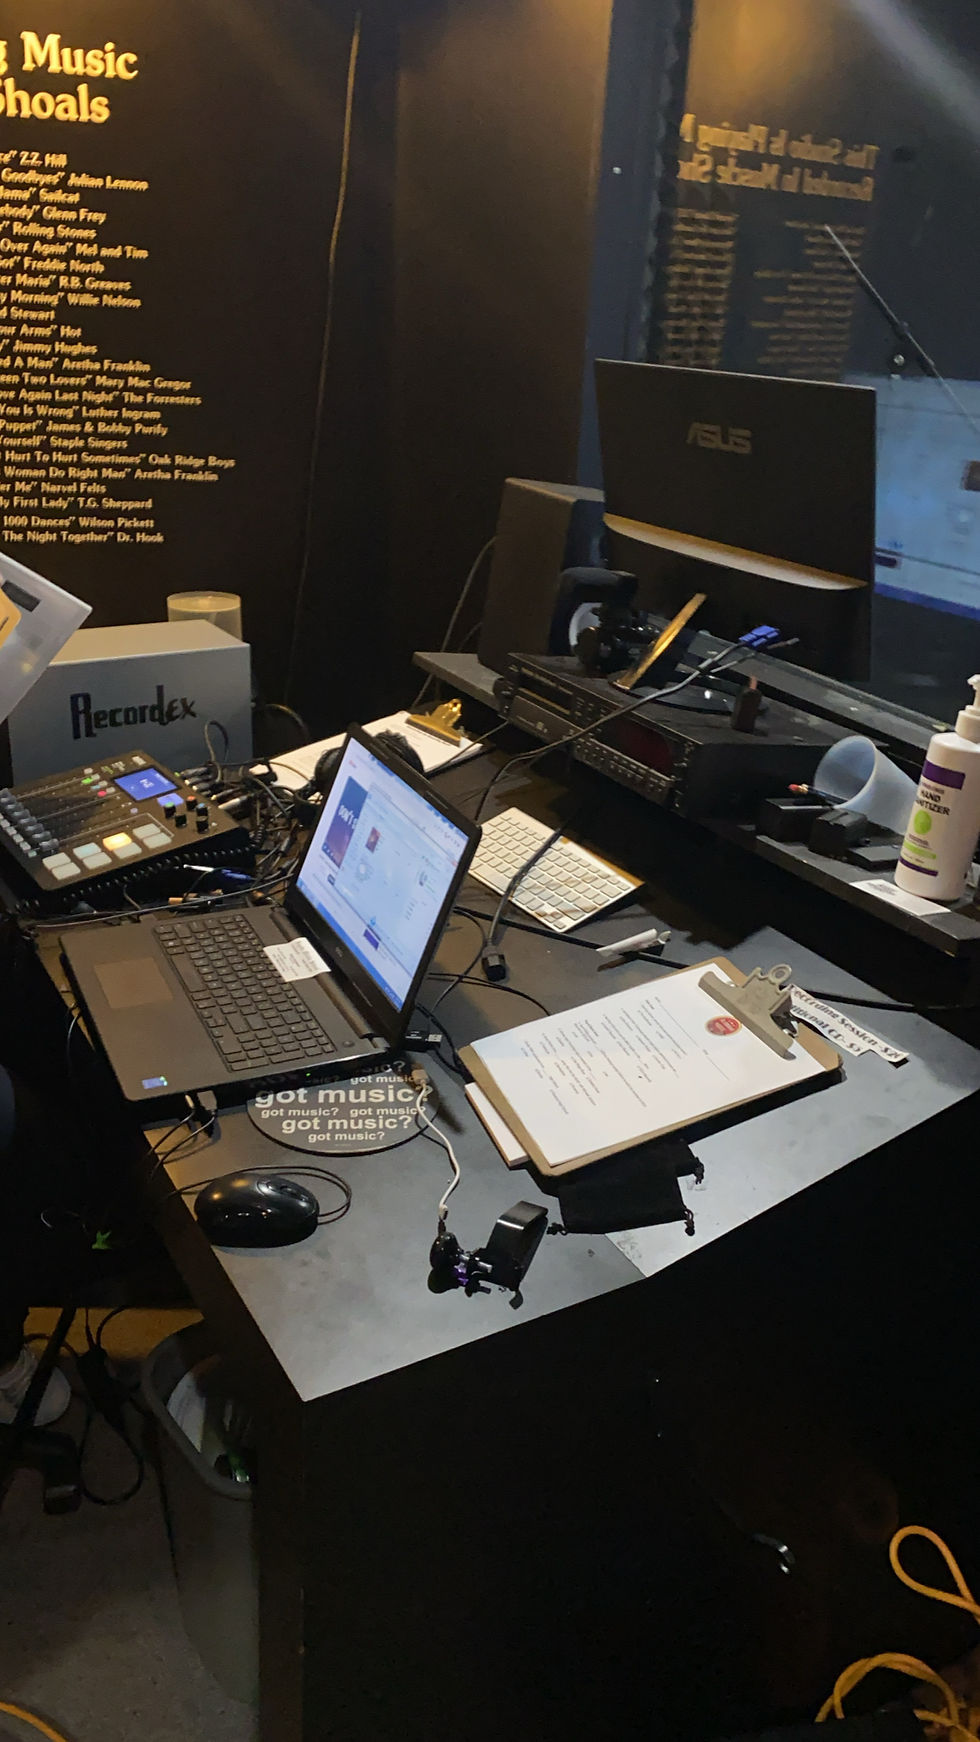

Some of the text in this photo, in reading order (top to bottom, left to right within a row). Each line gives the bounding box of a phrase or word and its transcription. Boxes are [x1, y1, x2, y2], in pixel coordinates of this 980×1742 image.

[20, 31, 139, 80] Music
[106, 175, 149, 191] Lennon
[42, 206, 78, 221] Glenn
[79, 208, 107, 225] Frey
[13, 221, 55, 239] Rolling
[56, 225, 97, 239] Stones
[0, 238, 30, 253] Over
[75, 242, 98, 256] Mel
[100, 245, 122, 258] and
[124, 245, 149, 259] Tim
[23, 256, 67, 271] Freddie
[69, 259, 105, 274] North
[67, 292, 100, 306] Willie
[102, 294, 142, 308] Nelson
[10, 306, 55, 321] Stewart
[60, 324, 82, 338] Hot
[13, 339, 52, 355] Jimmy
[54, 341, 98, 356] Hughes
[14, 356, 24, 369] A
[62, 357, 101, 371] Aretha
[103, 359, 151, 373] Franklin
[22, 371, 47, 385] Two
[95, 375, 125, 389] Mary
[153, 377, 192, 391] Gregor
[18, 388, 53, 403] Again
[54, 389, 80, 402] Last
[121, 391, 145, 404] The
[81, 406, 119, 418] Luther
[121, 407, 162, 421] Ingram
[46, 420, 82, 434] James
[83, 421, 95, 434] &
[97, 421, 132, 436] Bobby
[134, 422, 168, 437] Purify
[49, 435, 85, 450] Staple
[87, 436, 129, 451] Singers
[686, 422, 752, 455] ASUS
[5, 450, 31, 463] Hurt
[33, 450, 50, 463] To
[52, 451, 79, 464] Hurt
[148, 453, 172, 466] Oak
[174, 454, 206, 468] Ridge
[207, 455, 237, 469] Boys
[3, 465, 47, 479] Woman
[49, 466, 67, 479] Do
[68, 466, 99, 480] Right
[134, 468, 172, 481] Aretha
[173, 469, 219, 482] Franklin
[40, 482, 78, 494] Narvel
[13, 496, 39, 508] First
[101, 498, 153, 512] Sheppard
[3, 515, 29, 528] 1000
[78, 517, 116, 529] Wilson
[117, 518, 155, 530] Pickett
[2, 531, 24, 543] The
[26, 531, 58, 545] Night
[135, 533, 165, 545] Hook
[839, 1015, 877, 1047] Session
[350, 1075, 373, 1085] got
[255, 1086, 308, 1108] got
[261, 1107, 340, 1119] got music?
[350, 1107, 373, 1119] got
[282, 1115, 412, 1134] got music?
[308, 1131, 385, 1143] got music?
